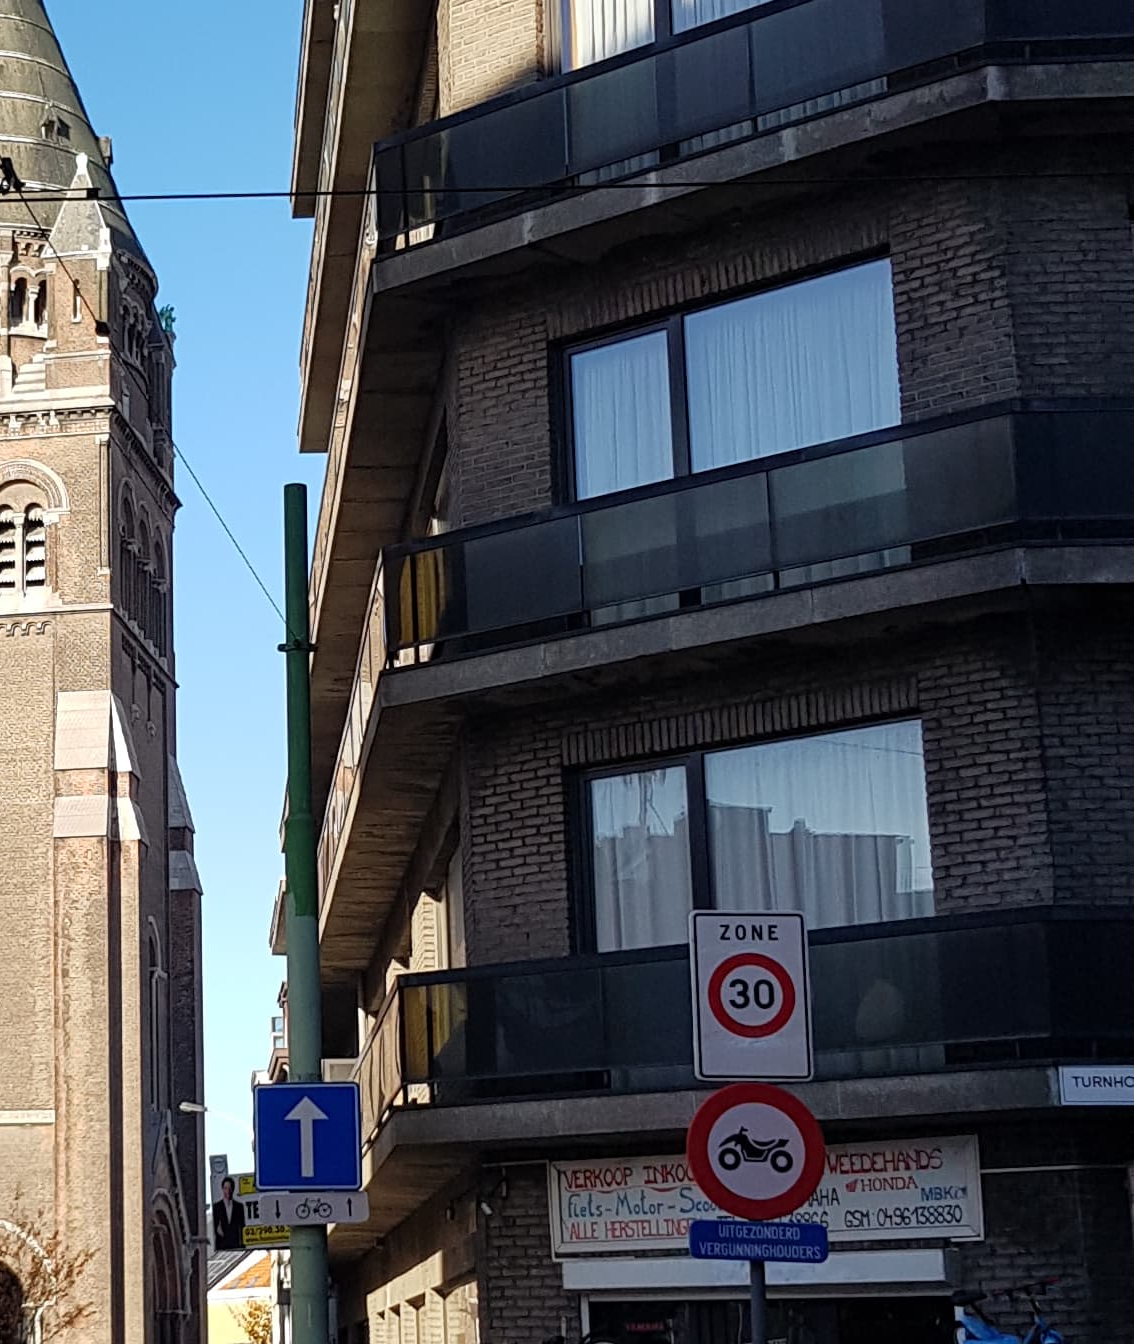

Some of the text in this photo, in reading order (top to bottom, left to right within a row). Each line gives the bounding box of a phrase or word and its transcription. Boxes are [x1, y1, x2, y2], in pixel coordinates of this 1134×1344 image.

[719, 924, 780, 942] ZONE
[728, 977, 775, 1010] 30
[1071, 1075, 1134, 1088] TURNHO
[563, 1167, 633, 1189] VERKOOP
[860, 1175, 918, 1192] HONDA
[876, 1204, 963, 1227] 0496138830
[569, 1221, 599, 1240] ALLE
[718, 1224, 801, 1240] UITGEZONDERD
[699, 1241, 821, 1259] VERGUNNINGHOUDERS
